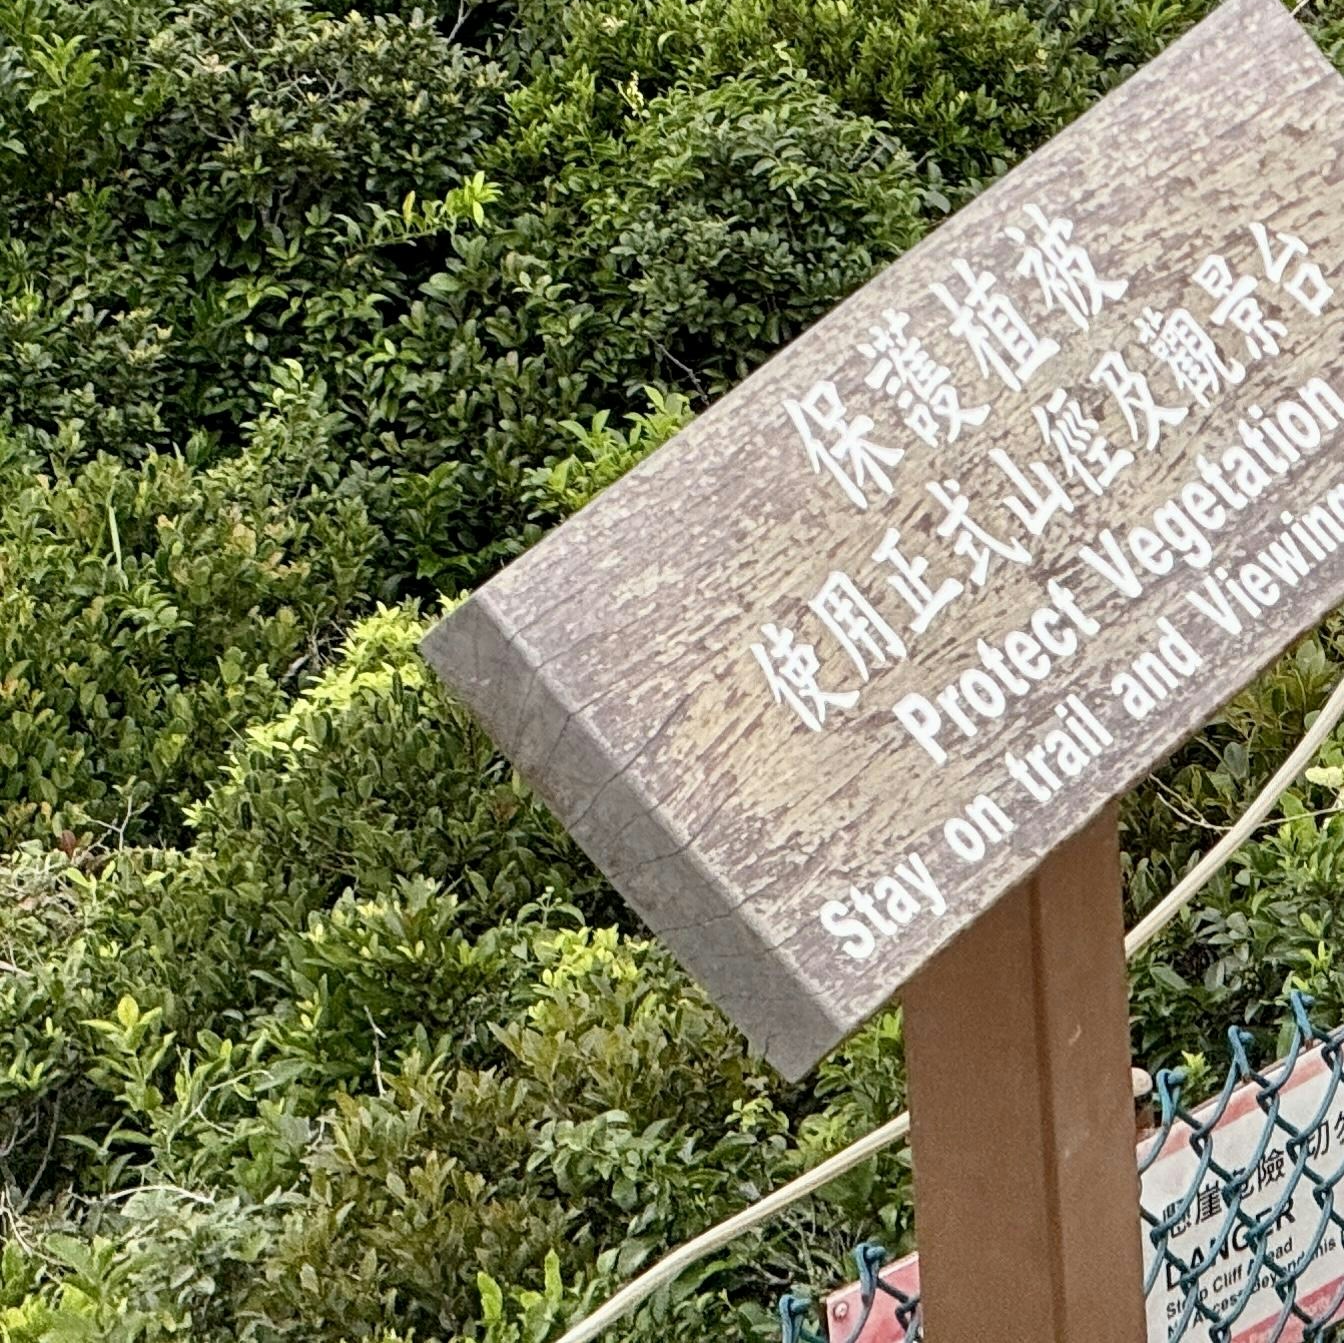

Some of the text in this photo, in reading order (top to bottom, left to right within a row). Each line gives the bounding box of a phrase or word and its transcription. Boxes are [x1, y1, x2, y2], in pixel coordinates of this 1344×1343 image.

[750, 221, 1335, 732] 使用正式山徑及觀景台
[781, 202, 1129, 509] 保護植被
[819, 852, 946, 958] Stay
[943, 793, 1015, 859] on
[1004, 693, 1114, 803] trail
[1110, 618, 1201, 721] and
[892, 578, 1101, 764] Protect
[1166, 1235, 1294, 1321] Stp Cliff ead
